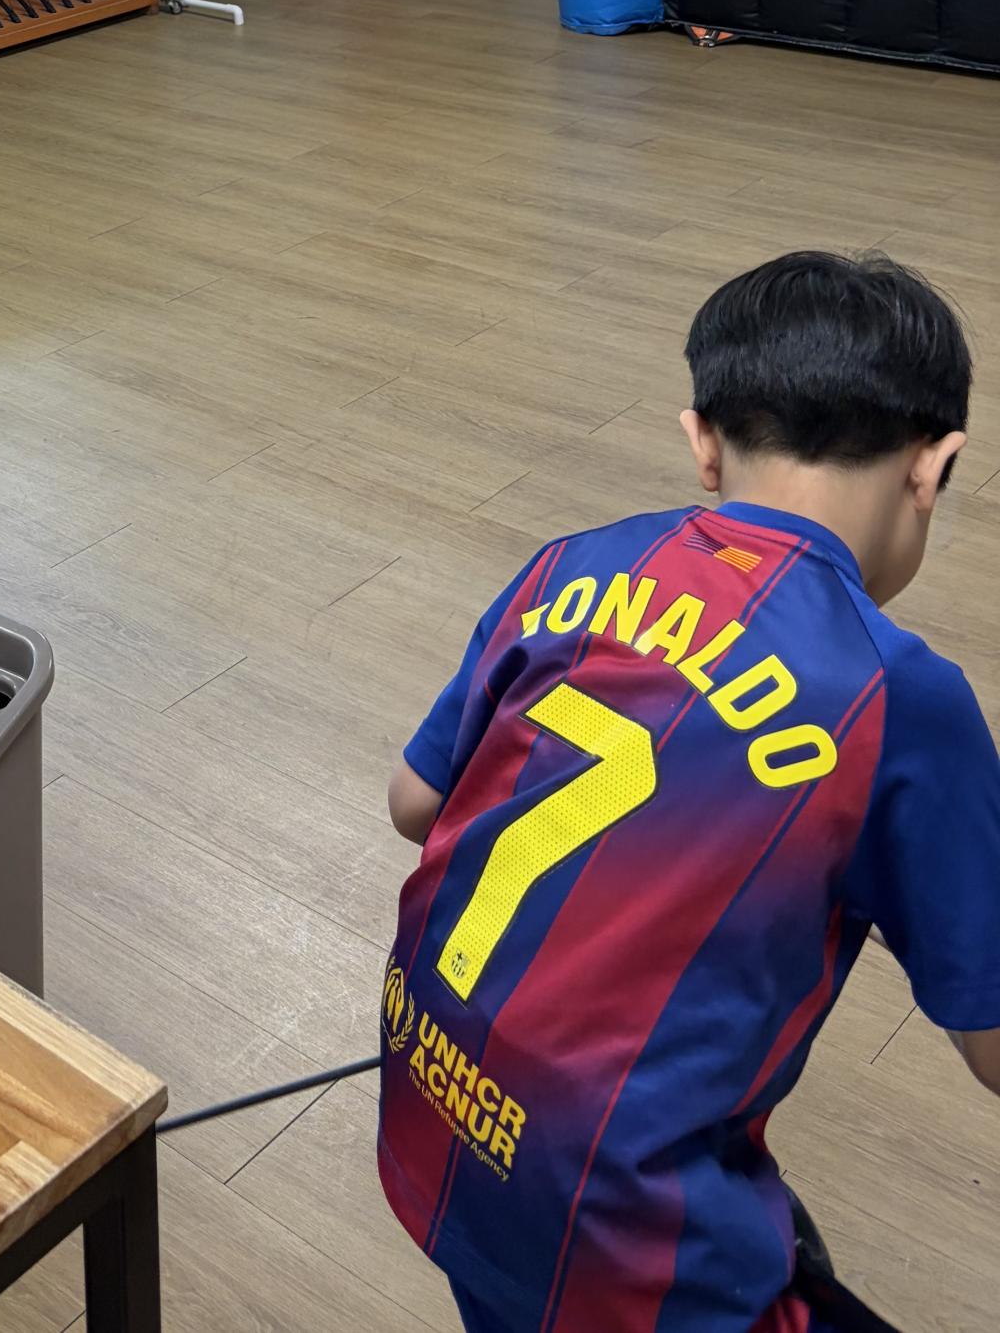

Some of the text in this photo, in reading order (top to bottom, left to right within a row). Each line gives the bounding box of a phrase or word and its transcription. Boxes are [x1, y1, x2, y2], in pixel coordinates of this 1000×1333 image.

[436, 682, 657, 1001] 7
[407, 1067, 510, 1183] The UN Refugee Agency
[409, 1044, 517, 1170] ACNUR
[418, 1011, 527, 1140] UNHCR
